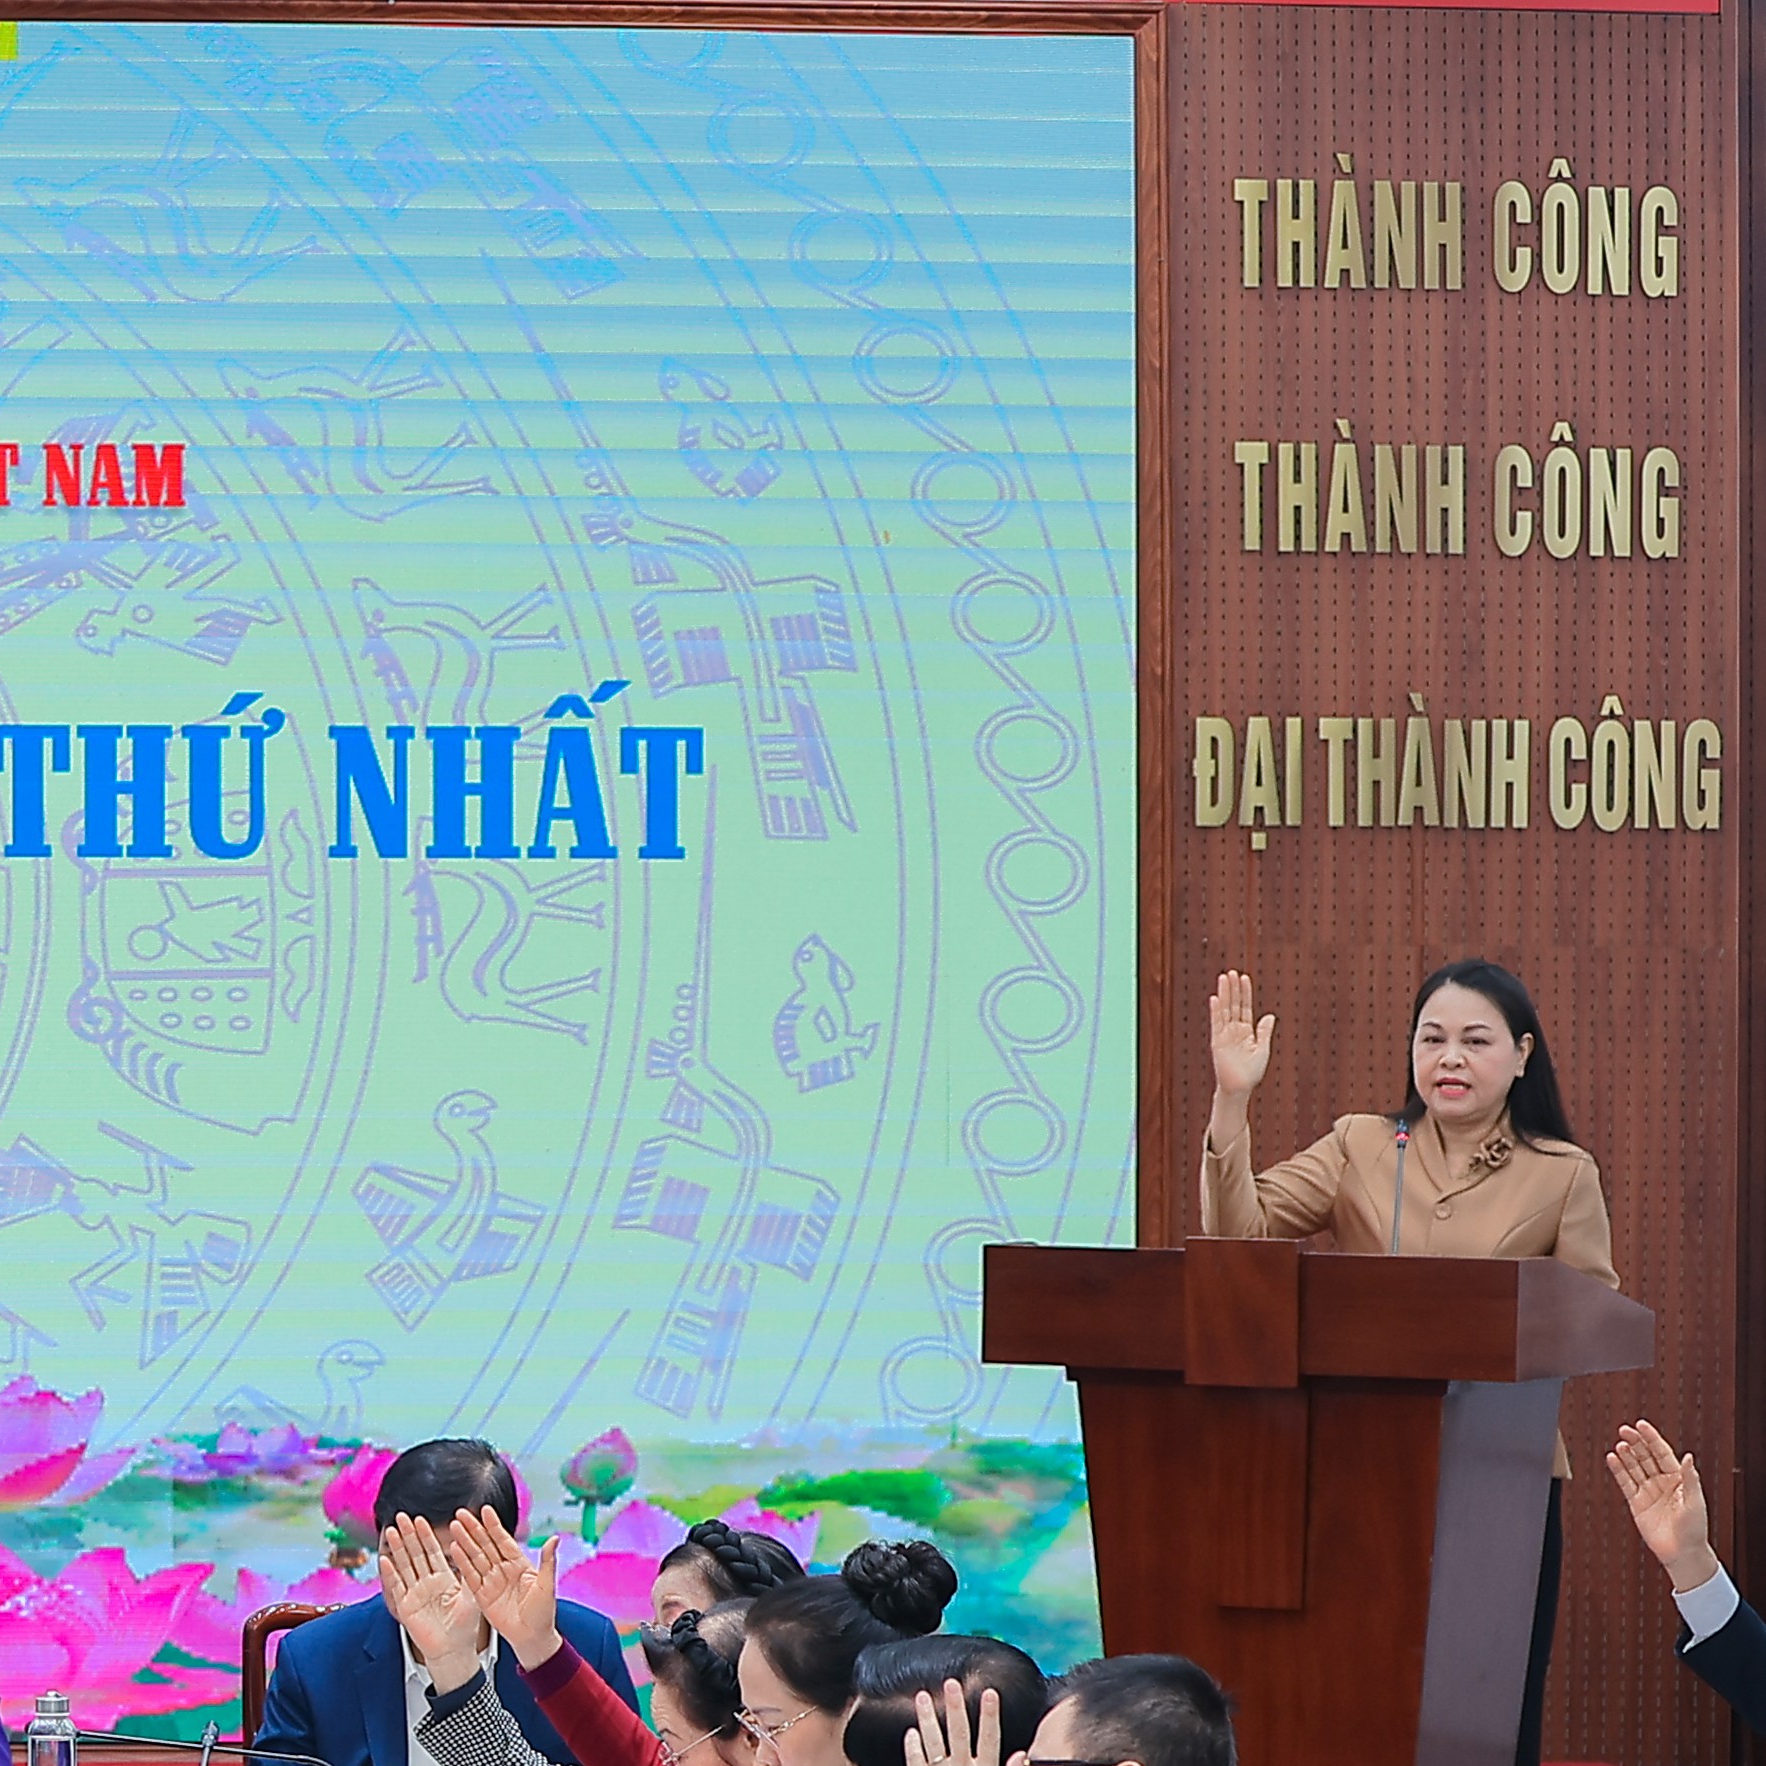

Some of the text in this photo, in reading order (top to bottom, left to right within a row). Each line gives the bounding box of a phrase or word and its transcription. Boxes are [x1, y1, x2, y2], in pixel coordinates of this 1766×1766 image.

[1233, 153, 1678, 298] THÀNH CÔNG
[43, 442, 186, 508] NAM
[1233, 417, 1680, 559] THÀNH CÔNG
[329, 679, 704, 860] NHẤT
[1192, 692, 1722, 851] ĐẠI THÀNH CÔNG
